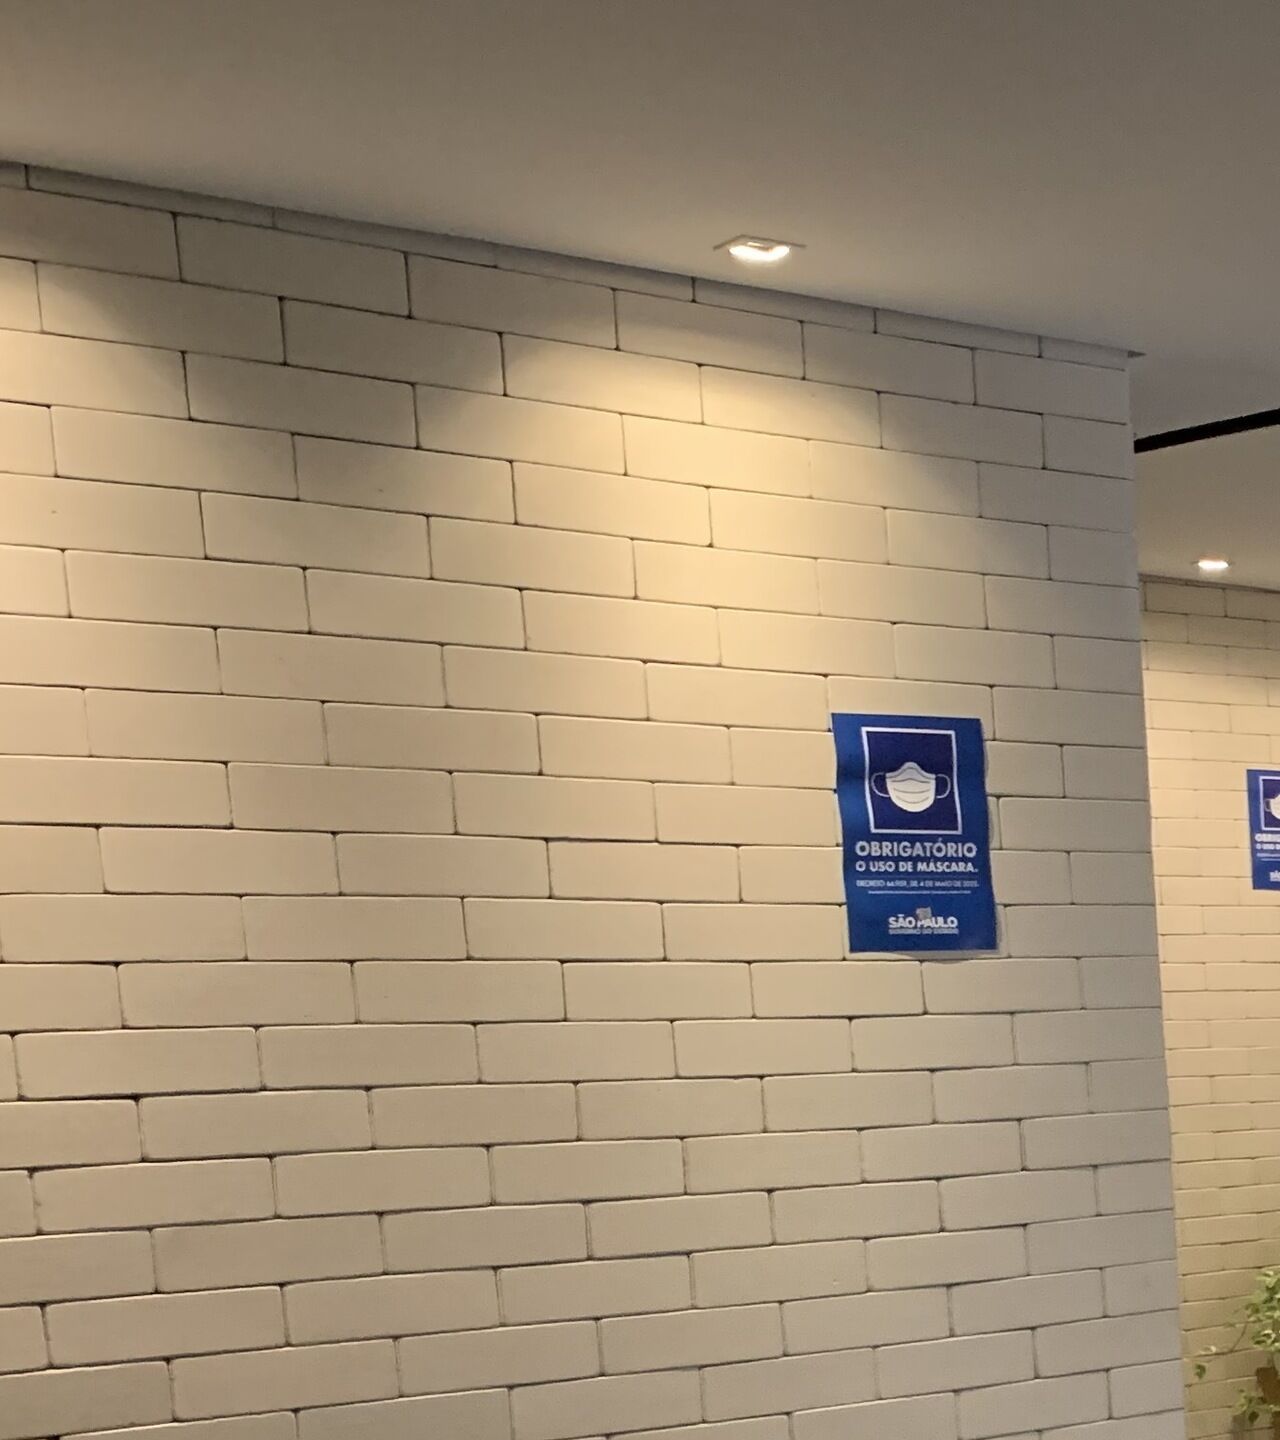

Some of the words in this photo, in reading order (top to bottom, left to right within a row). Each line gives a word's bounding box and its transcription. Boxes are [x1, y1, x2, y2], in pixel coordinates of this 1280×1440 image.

[855, 837, 978, 858] OBRIGATÓRIO
[855, 860, 866, 872] O
[869, 860, 895, 872] USO
[898, 861, 914, 872] DE
[917, 859, 979, 873] MÁSCARA.
[888, 913, 916, 929] SÃO
[916, 916, 959, 929] PAULO
